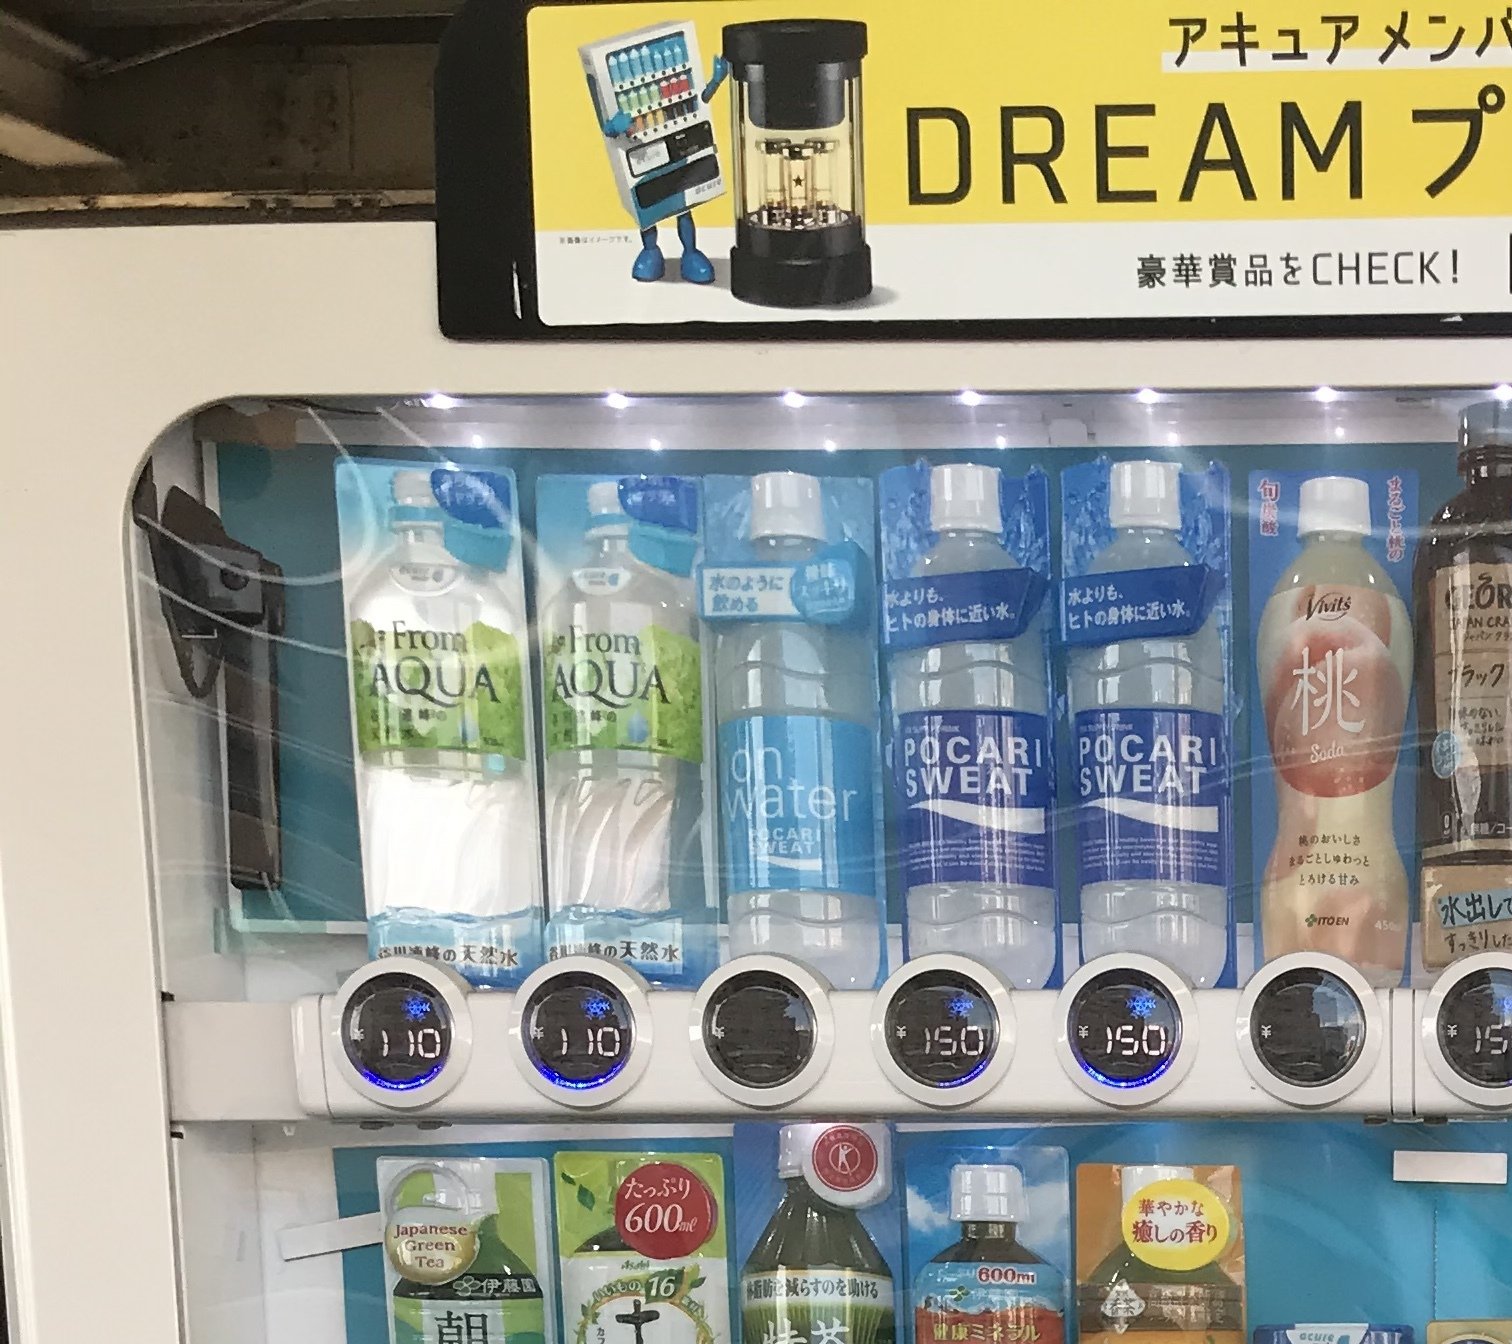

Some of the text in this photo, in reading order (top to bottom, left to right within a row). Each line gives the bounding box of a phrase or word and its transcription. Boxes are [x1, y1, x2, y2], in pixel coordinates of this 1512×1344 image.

[906, 99, 1364, 207] DREAM
[1135, 248, 1460, 291] 豪華賞品をCHECK!
[709, 575, 785, 592] 水のように
[393, 620, 468, 652] From
[569, 624, 641, 656] From
[369, 655, 502, 709] AQUA
[551, 658, 671, 710] AQUA
[1291, 646, 1367, 737] 桃
[904, 735, 1042, 768] POCARI
[1079, 734, 1216, 767] POCARI
[905, 765, 1033, 799] SWEAT
[1080, 764, 1208, 798] SWEAT
[722, 776, 858, 822] water
[924, 1025, 985, 1056] 150
[1105, 1025, 1166, 1056] 150
[624, 1177, 691, 1200] たっぷり
[1138, 1199, 1205, 1216] 華やかな
[393, 1221, 469, 1239] Japanese
[405, 1237, 457, 1254] Green
[1131, 1218, 1219, 1246] 癒しの香り
[414, 1254, 446, 1270] Tea
